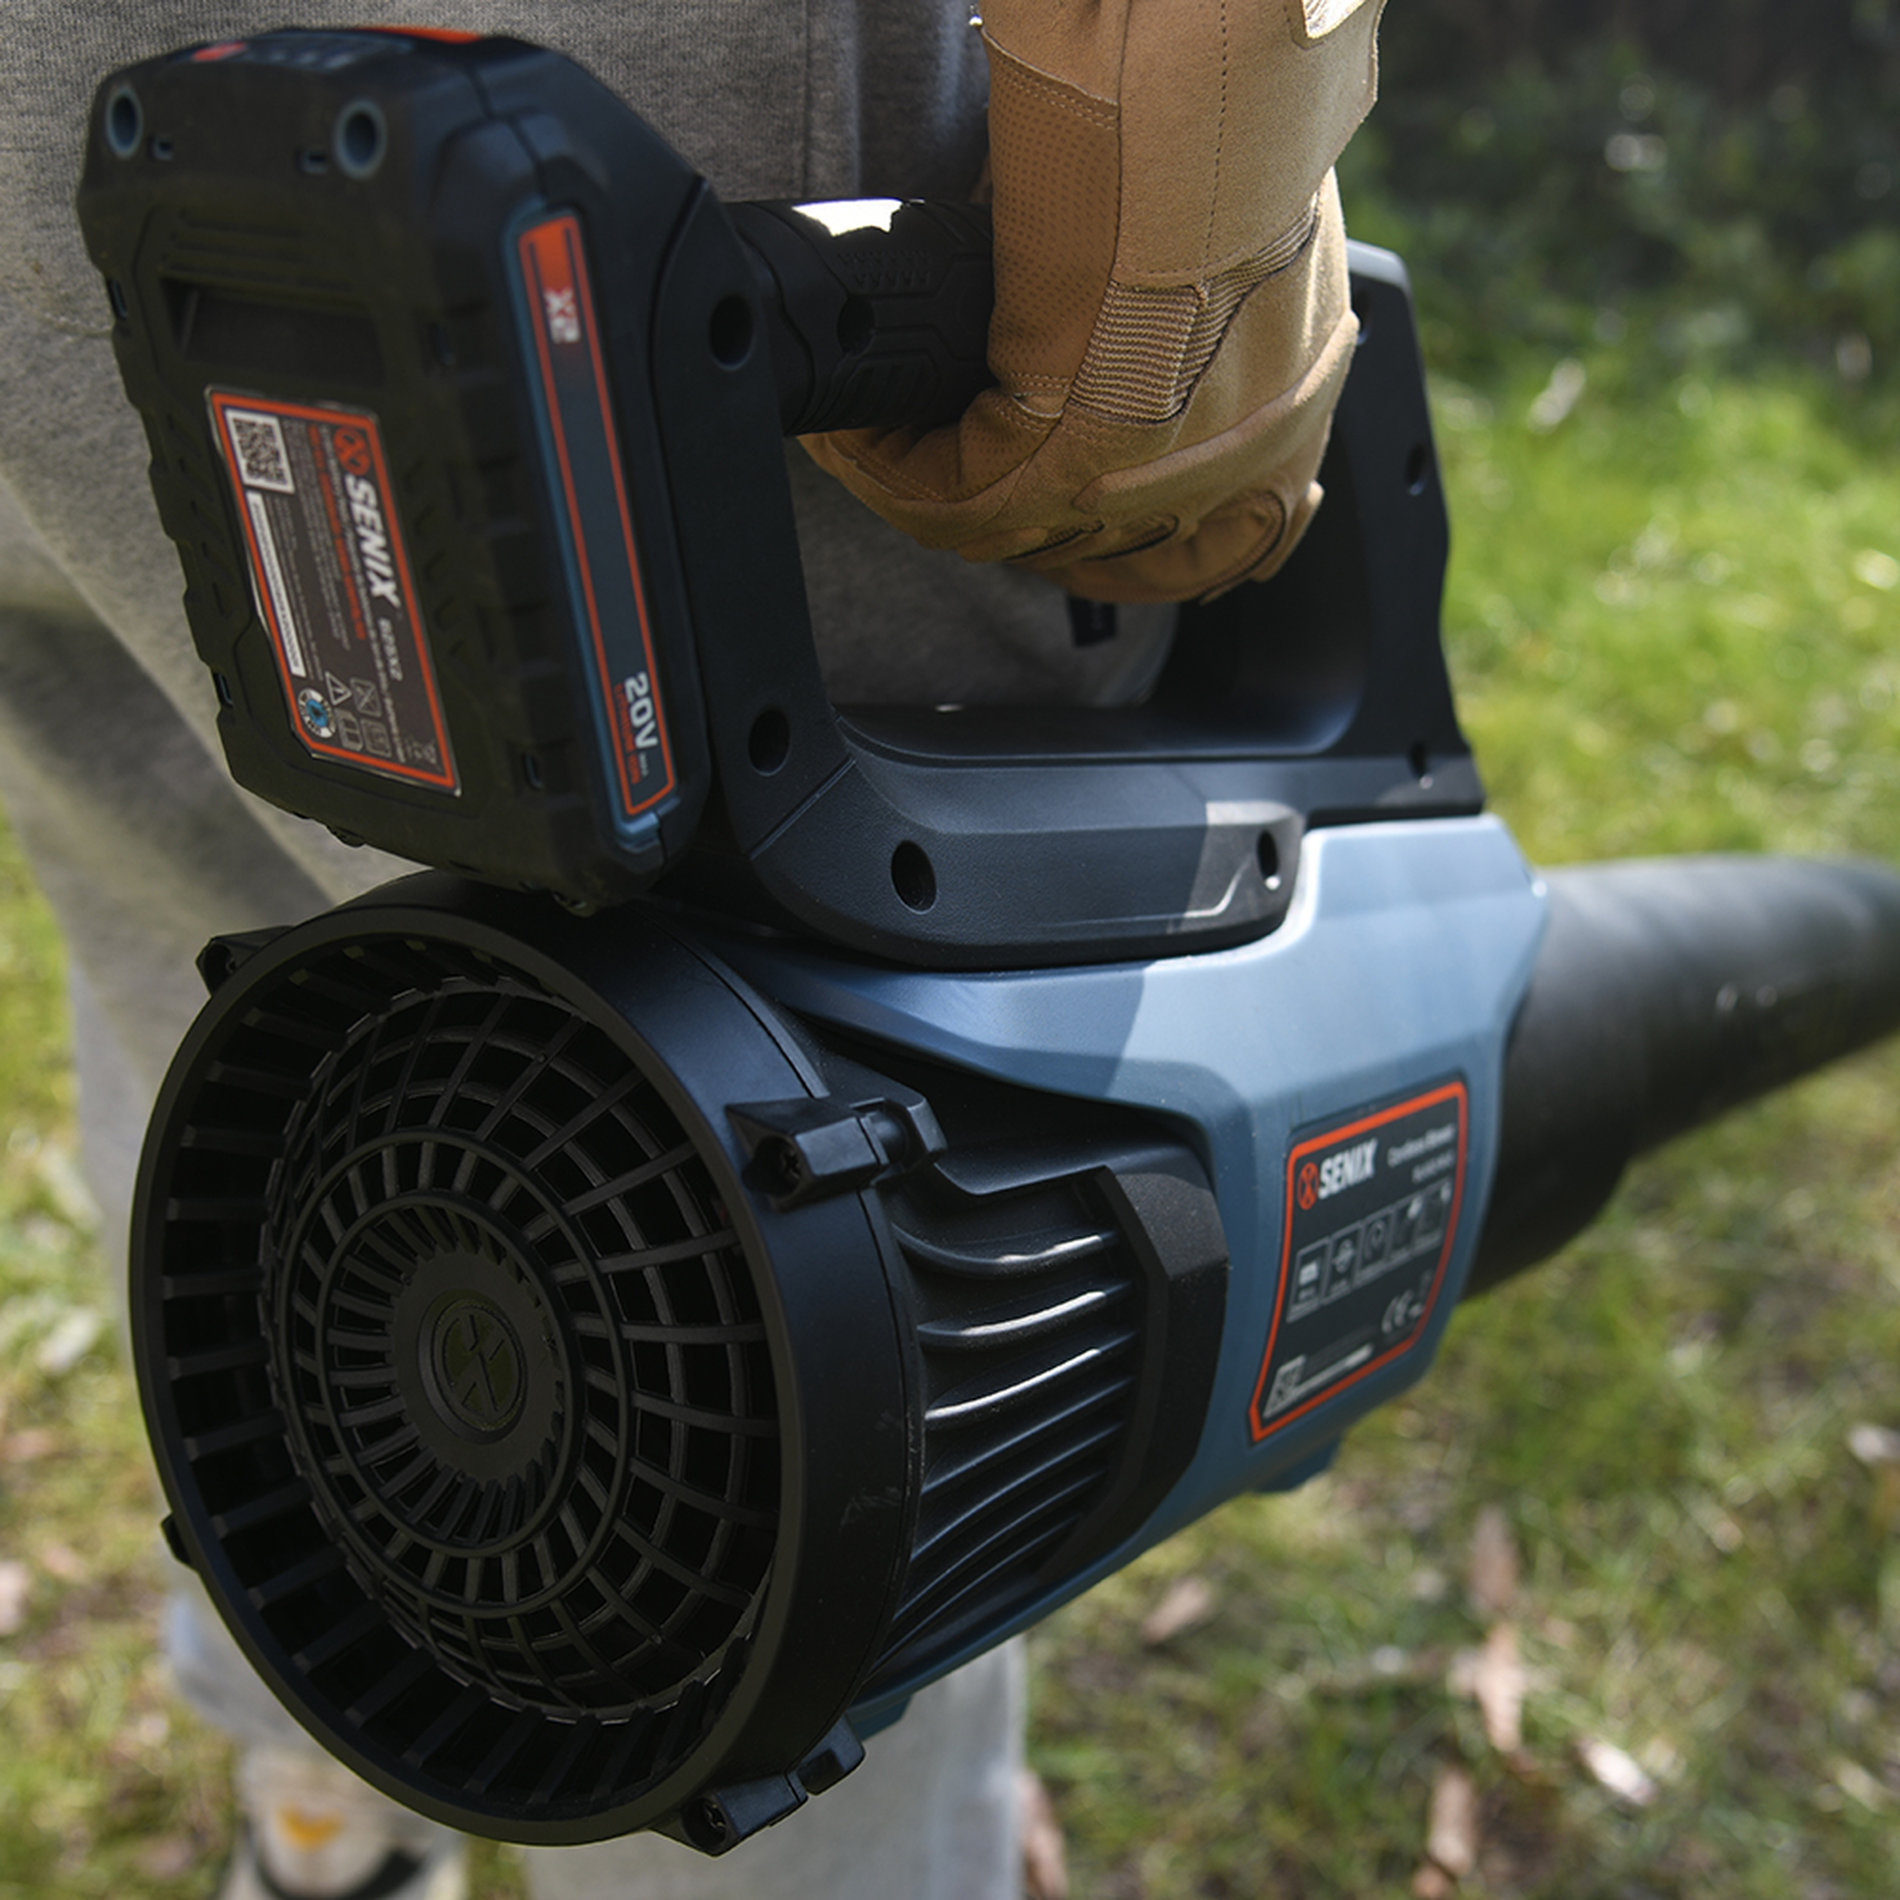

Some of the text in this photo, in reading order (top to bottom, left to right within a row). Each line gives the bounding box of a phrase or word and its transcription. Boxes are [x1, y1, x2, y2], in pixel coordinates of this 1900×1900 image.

[544, 287, 580, 343] X2
[344, 472, 401, 608] SENIX
[624, 671, 658, 749] 20V
[1317, 1138, 1378, 1200] SENIX
